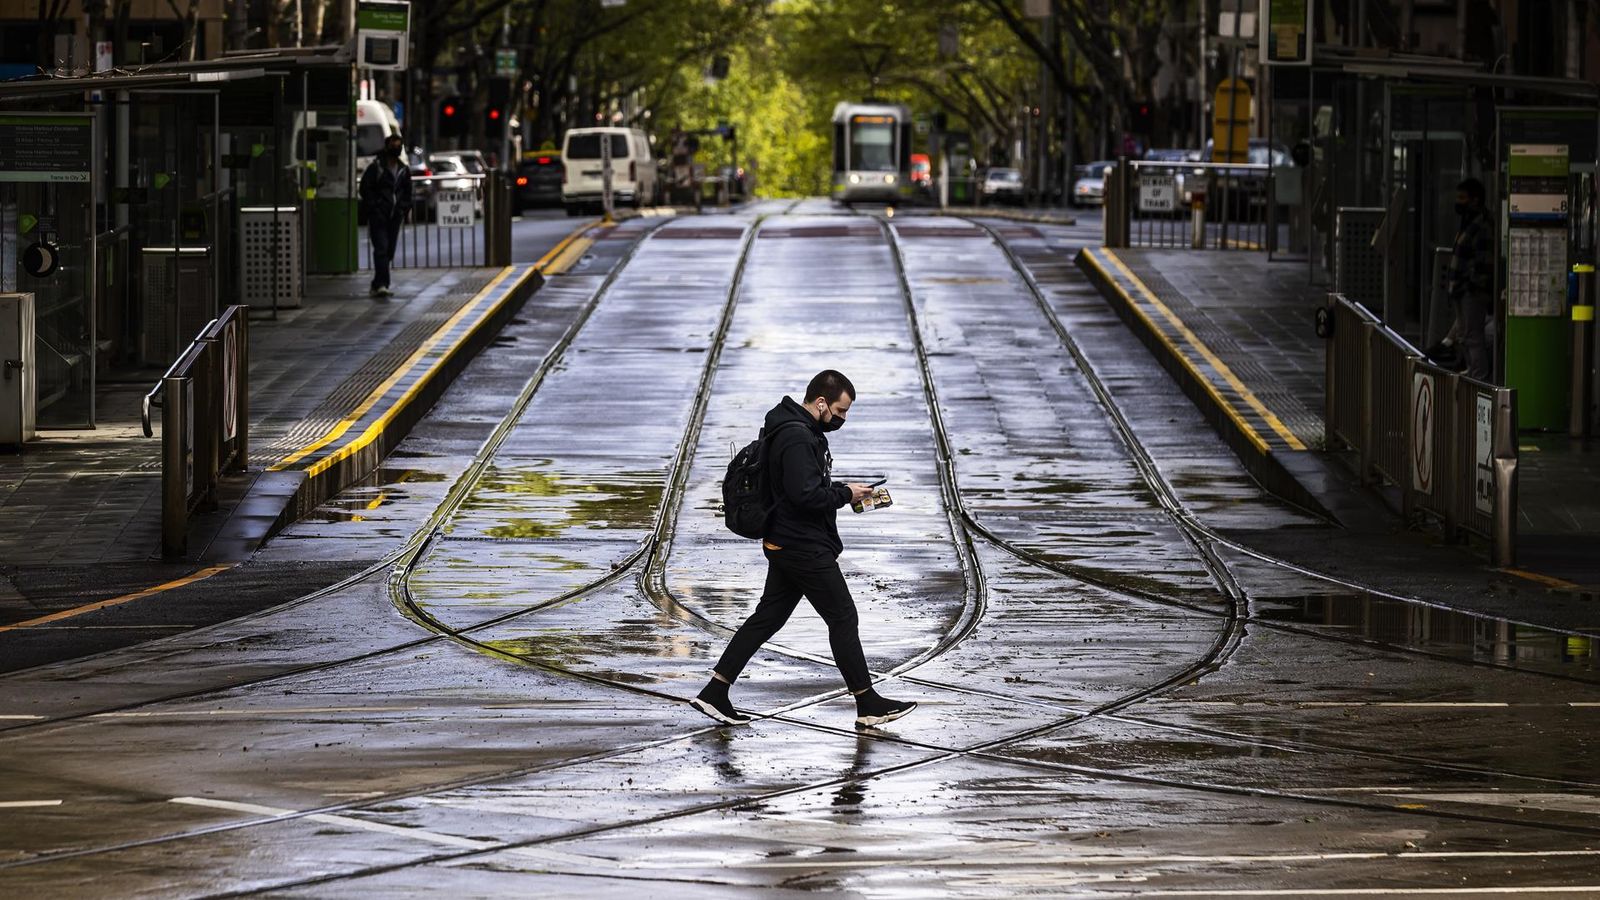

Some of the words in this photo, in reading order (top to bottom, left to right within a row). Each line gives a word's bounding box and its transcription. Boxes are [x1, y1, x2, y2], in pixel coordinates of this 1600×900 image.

[439, 192, 471, 201] BEWARE
[450, 204, 460, 214] OF
[443, 216, 470, 225] TRAMS
